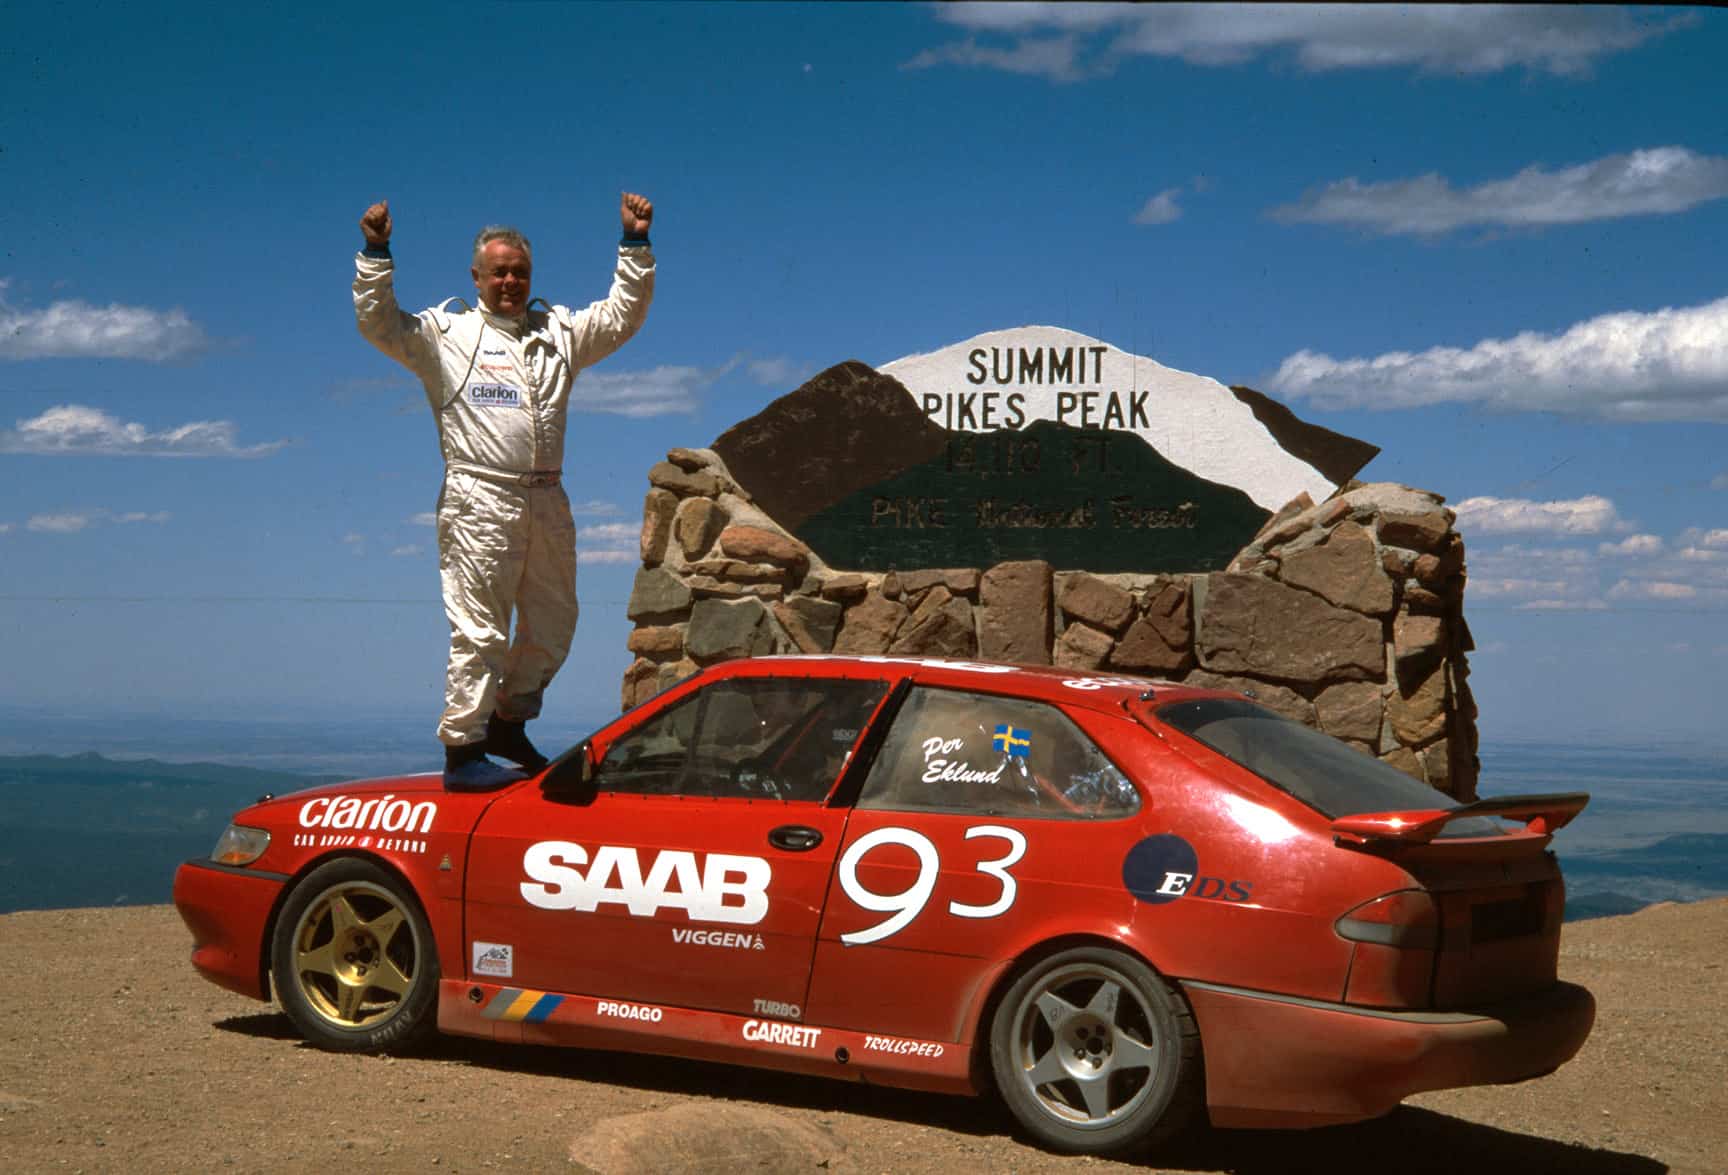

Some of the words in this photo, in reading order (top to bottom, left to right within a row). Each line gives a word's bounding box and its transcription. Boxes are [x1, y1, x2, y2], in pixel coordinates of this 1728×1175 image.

[967, 346, 1107, 385] SUMMIT
[921, 392, 1026, 430] PIKES
[1056, 391, 1151, 429] PEAK
[871, 497, 949, 529] PIKE
[921, 759, 1008, 784] Eklund
[376, 837, 427, 854] BEYOND
[519, 840, 773, 925] SAAB
[838, 825, 1028, 947] 93
[1155, 871, 1255, 901] EDS
[671, 928, 753, 949] VIGGEN
[596, 1001, 663, 1023] PROAGO
[753, 998, 801, 1019] TURBO
[742, 1019, 822, 1048] GARRETT
[863, 1035, 945, 1058] TROLLSPEED
